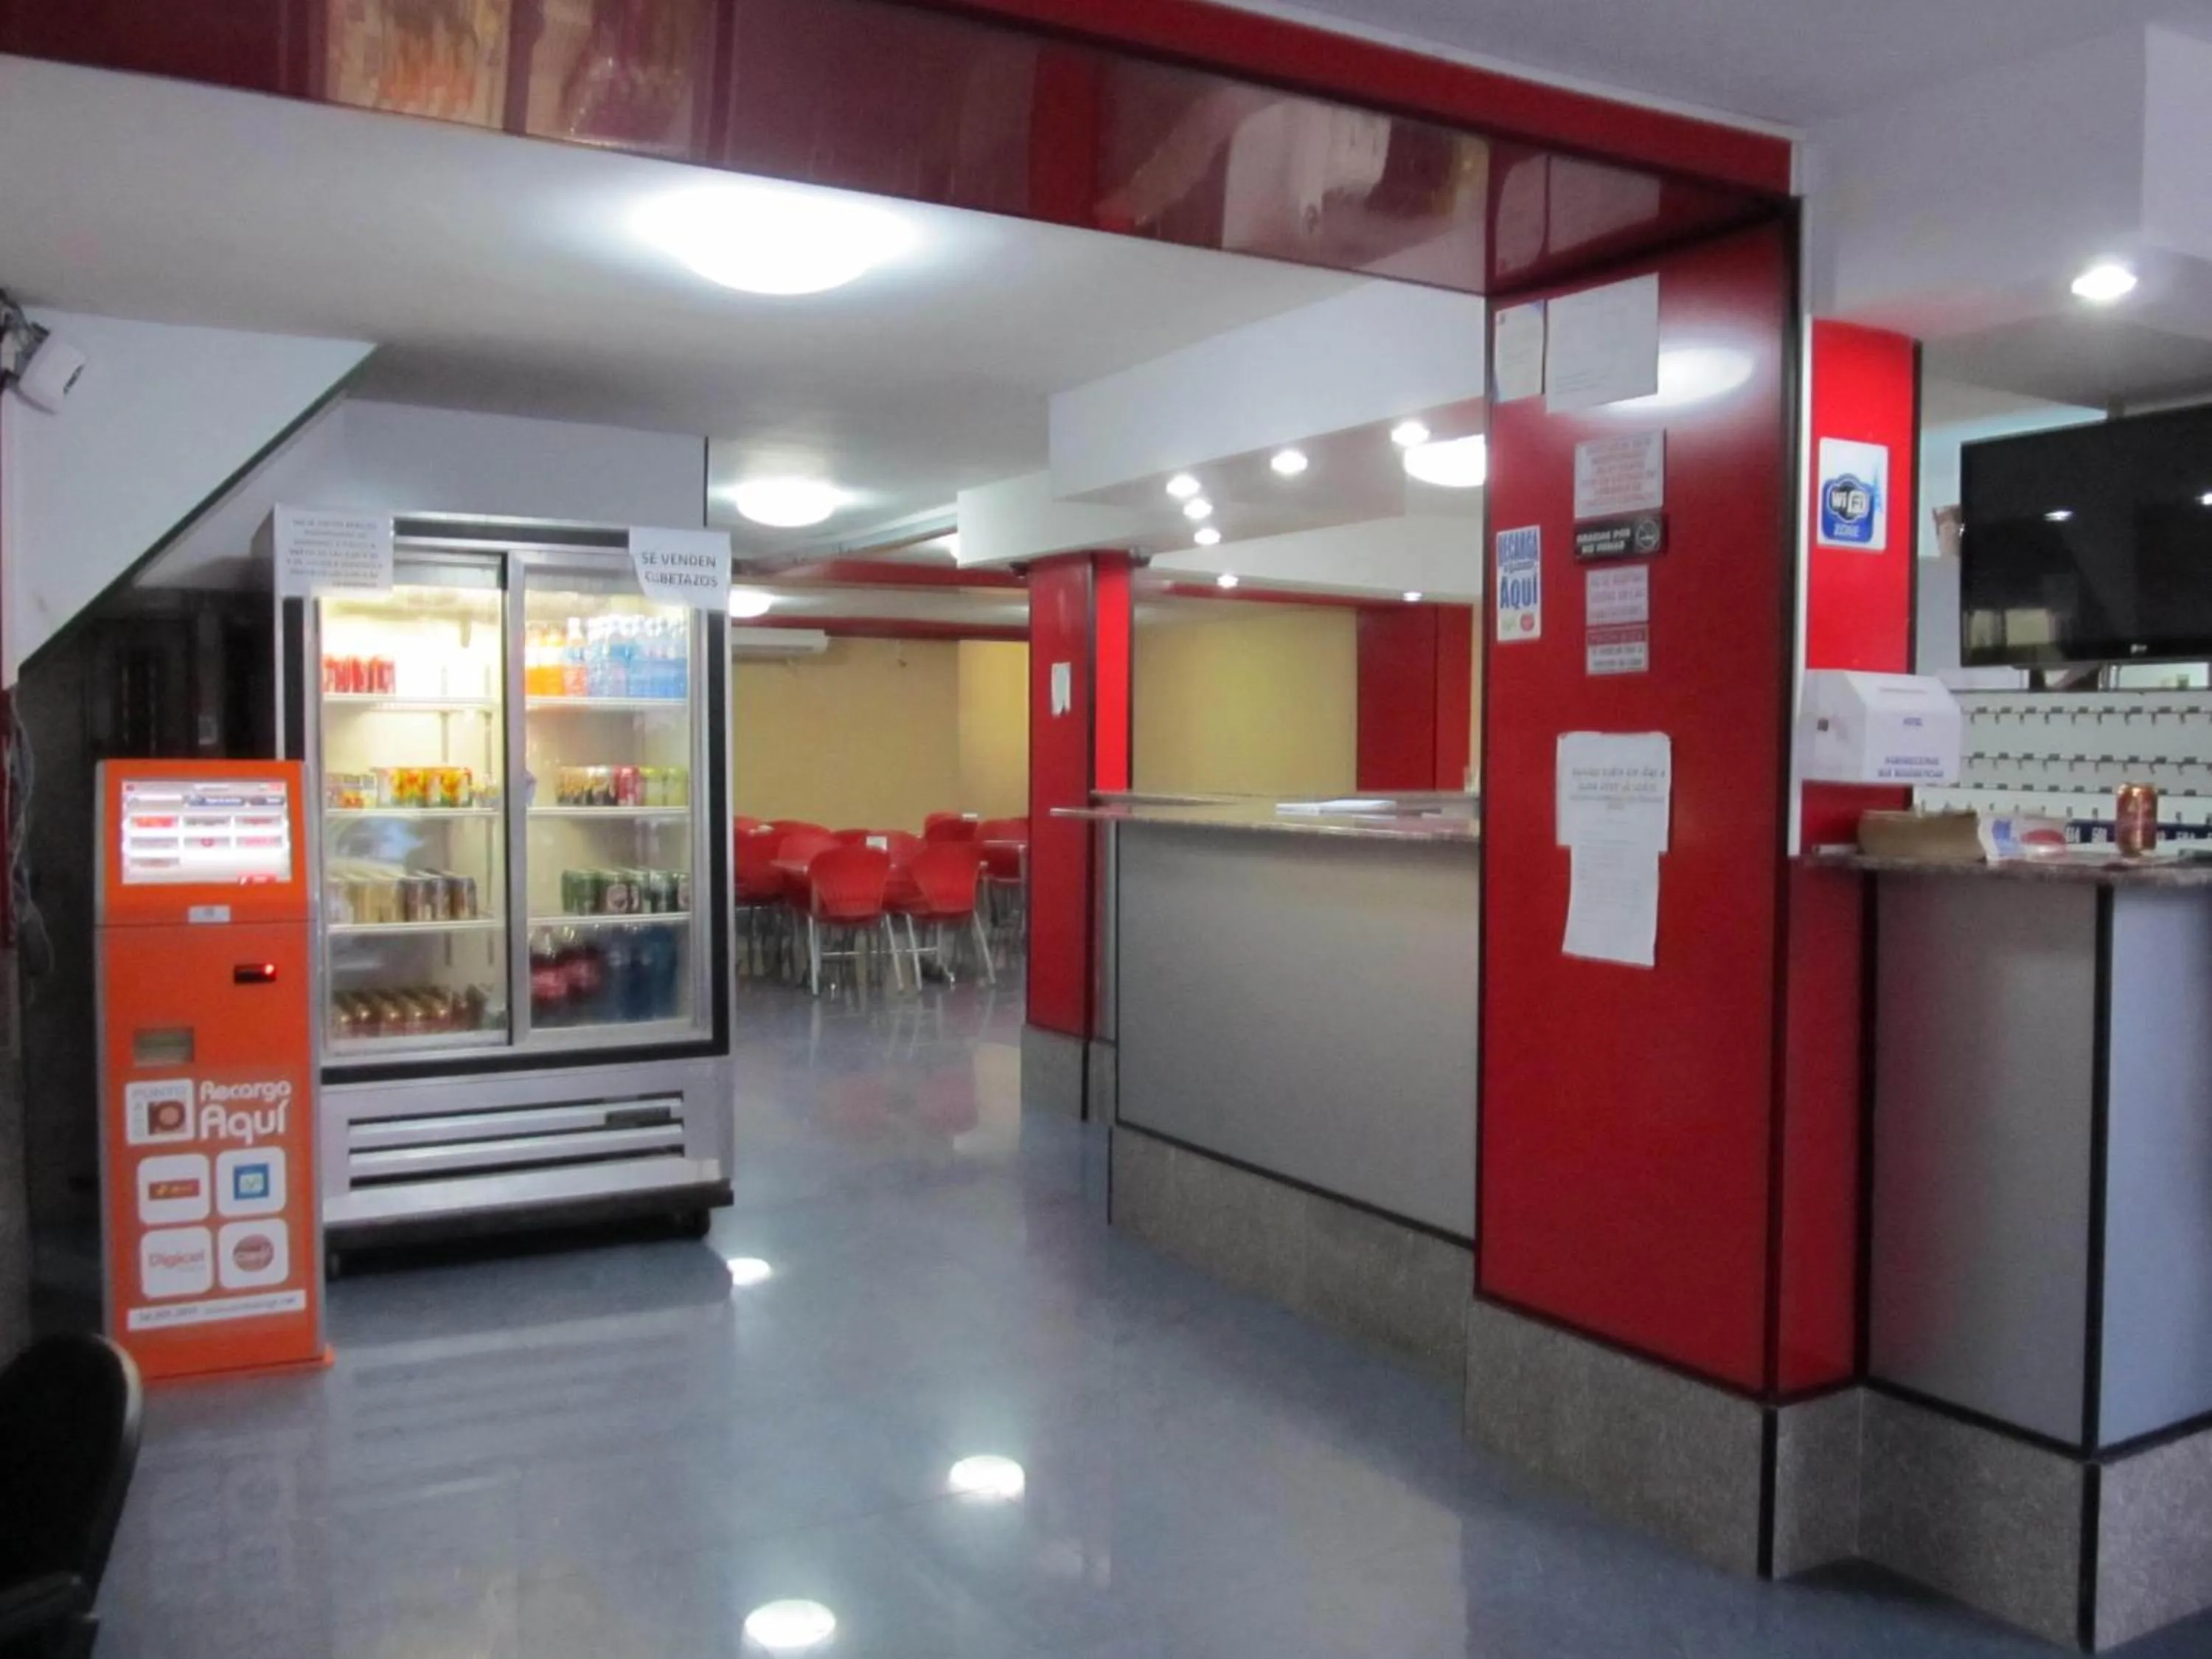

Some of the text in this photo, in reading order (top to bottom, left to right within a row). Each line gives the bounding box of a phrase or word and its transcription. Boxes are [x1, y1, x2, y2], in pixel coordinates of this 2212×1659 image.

[641, 551, 717, 568] SE VENDEN
[644, 570, 719, 589] CUBETAZOS
[200, 1079, 293, 1104] Recarga
[199, 1099, 289, 1145] Aquí
